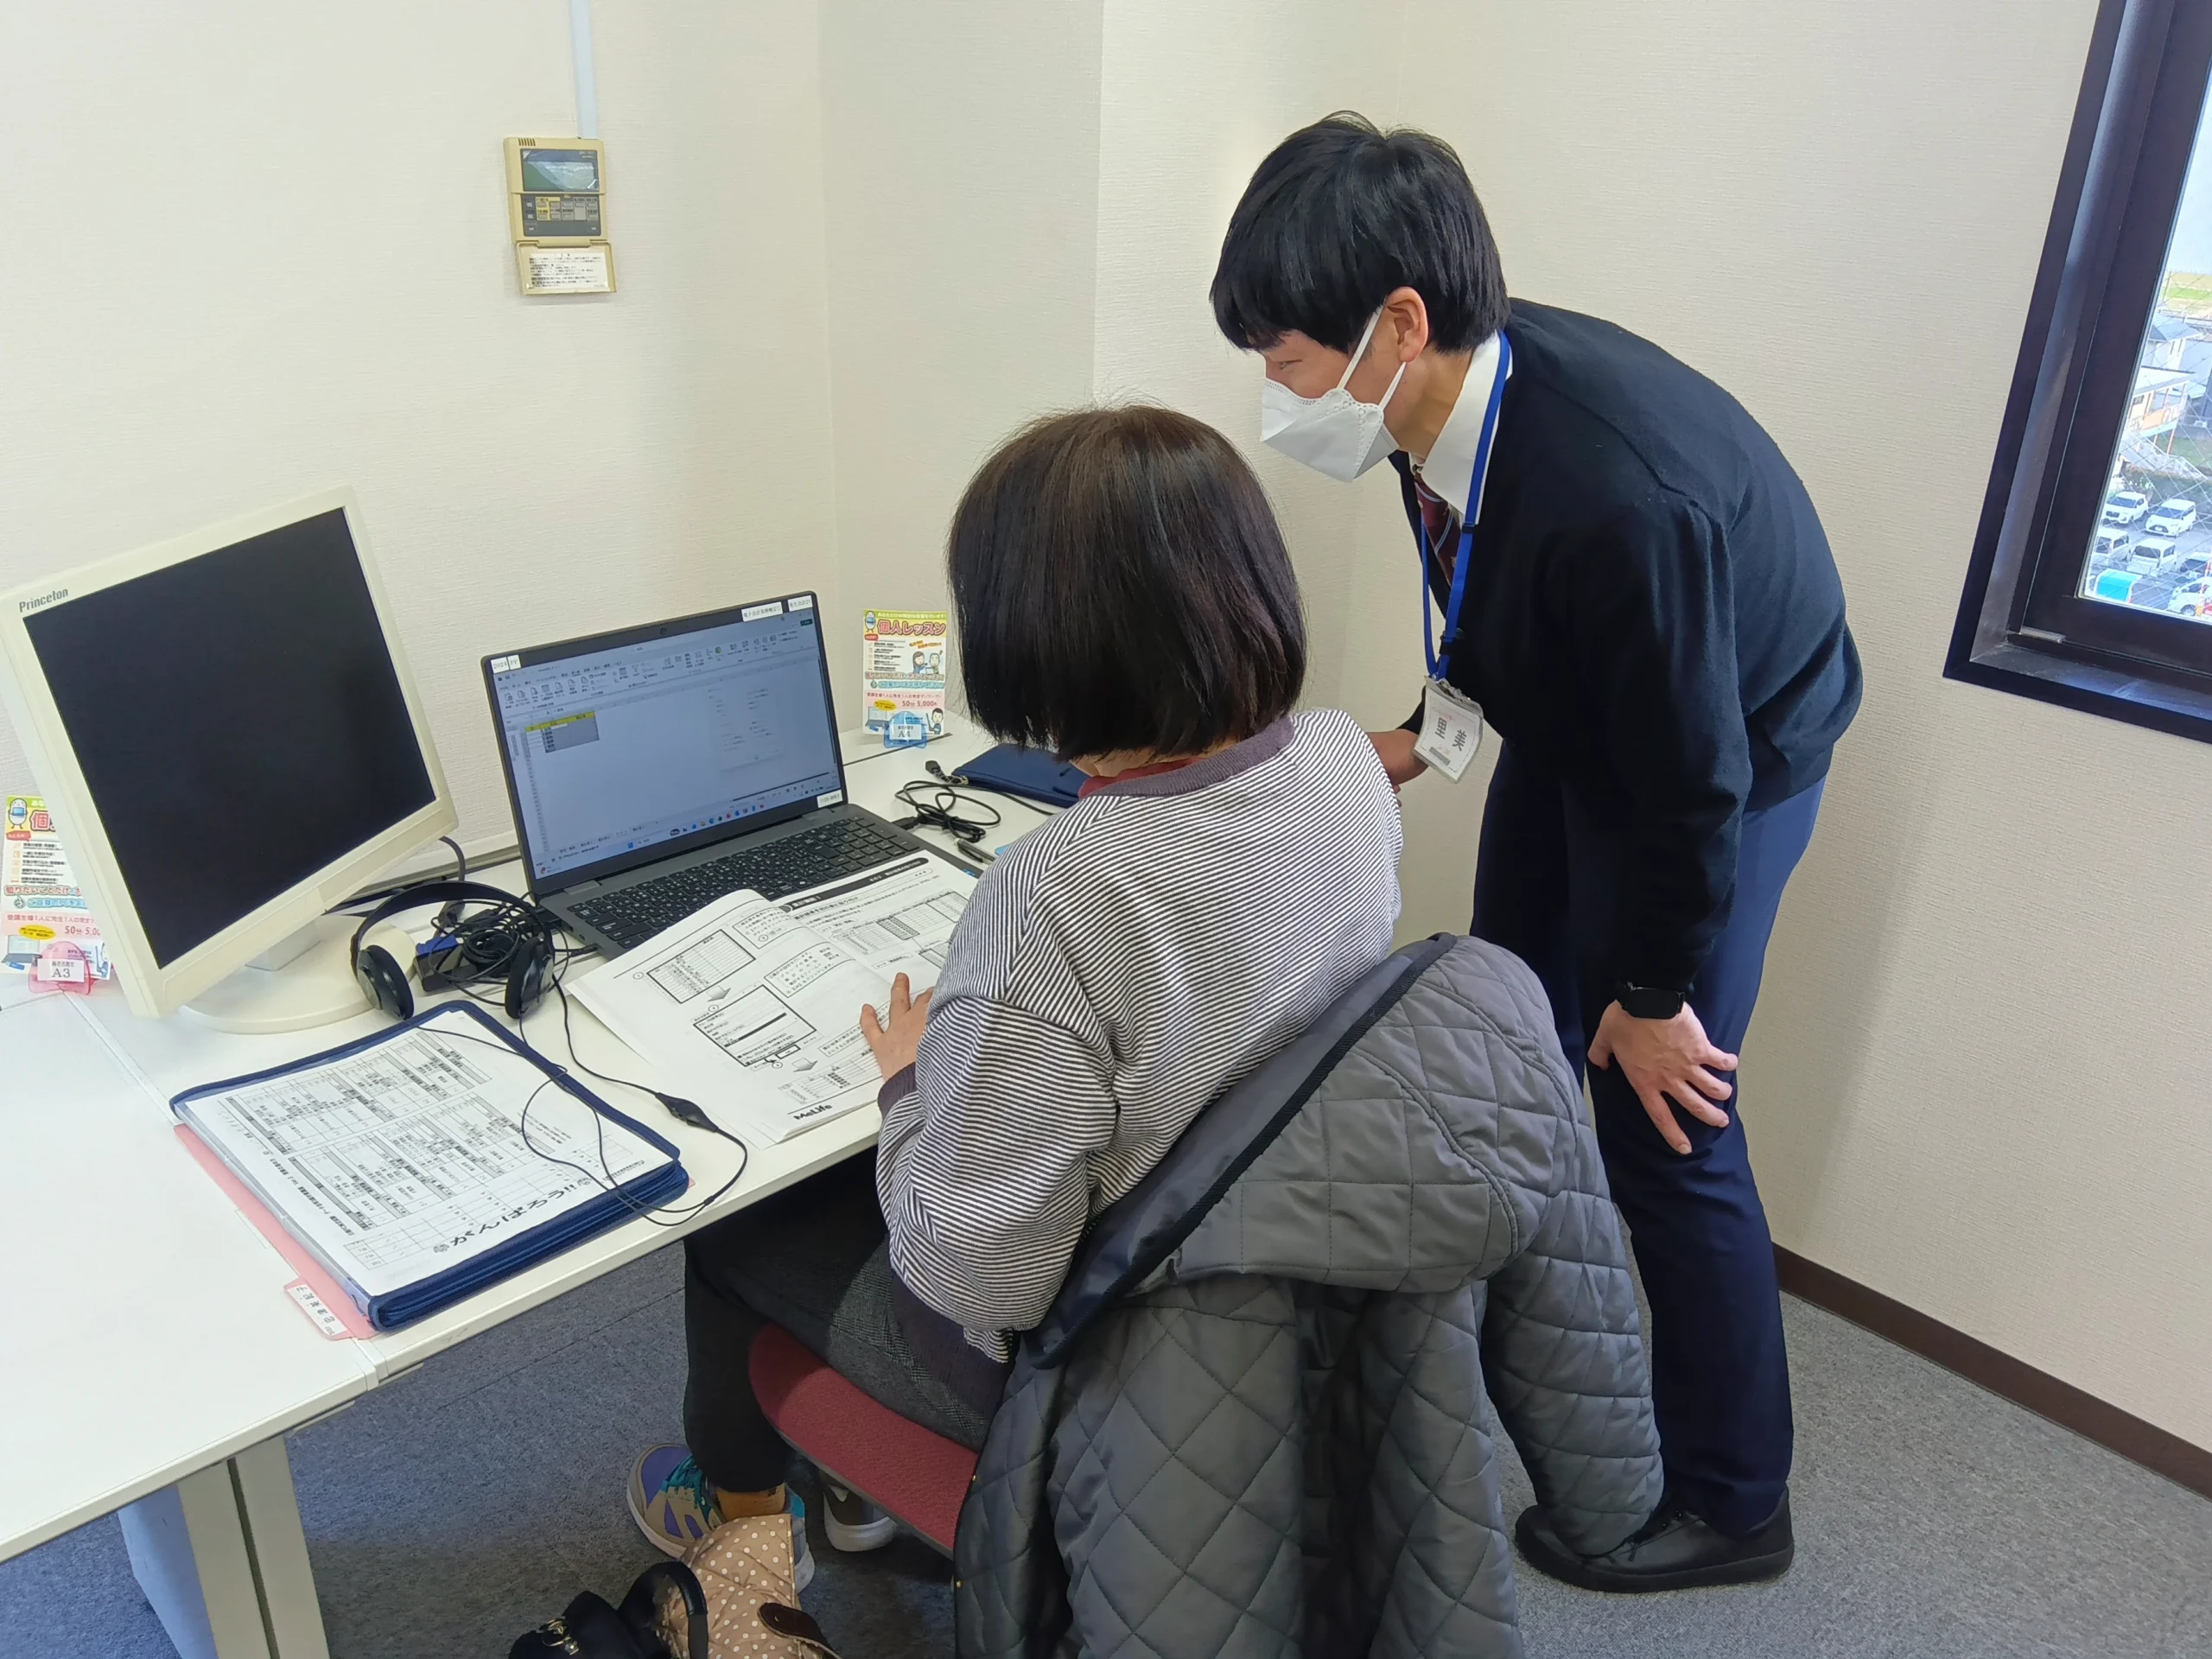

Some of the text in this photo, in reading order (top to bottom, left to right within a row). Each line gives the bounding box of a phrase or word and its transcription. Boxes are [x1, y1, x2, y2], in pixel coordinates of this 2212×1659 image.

[19, 588, 68, 613] Princeton
[878, 620, 946, 635] 個人レッスン
[493, 661, 508, 670] 2024
[52, 969, 71, 978] A3
[793, 1105, 832, 1120] MeLife
